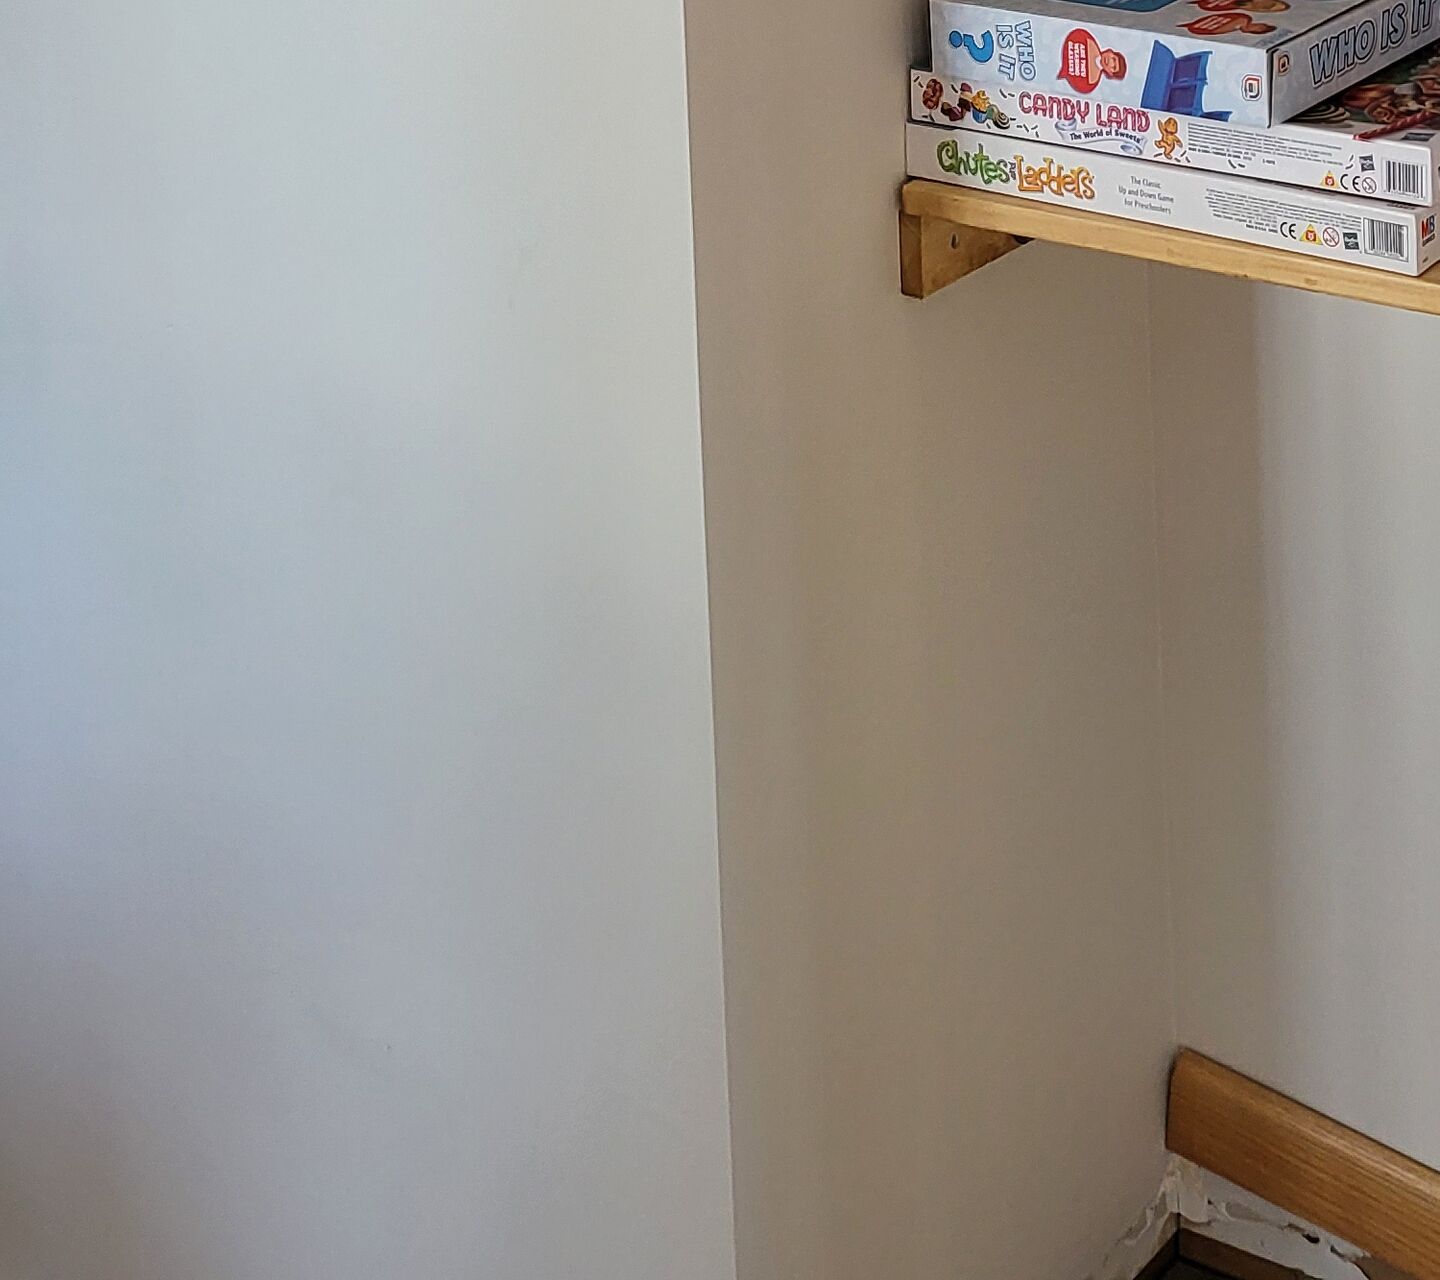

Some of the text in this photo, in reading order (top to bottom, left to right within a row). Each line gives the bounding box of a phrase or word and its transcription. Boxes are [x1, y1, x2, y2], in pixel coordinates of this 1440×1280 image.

[996, 24, 1013, 49] IS
[1308, 20, 1377, 87] WHO
[1380, 2, 1407, 52] IS
[1015, 20, 1036, 81] WHO
[999, 51, 1016, 81] IT
[1019, 91, 1150, 133] CANDY LAND
[1070, 128, 1142, 143] The World of Sweets
[937, 140, 1010, 185] Chutes
[1014, 155, 1096, 200] Ladders
[1130, 176, 1142, 184] The
[1118, 186, 1174, 203] Up and Down Game
[1124, 198, 1132, 207] for
[1421, 215, 1435, 240] MB
